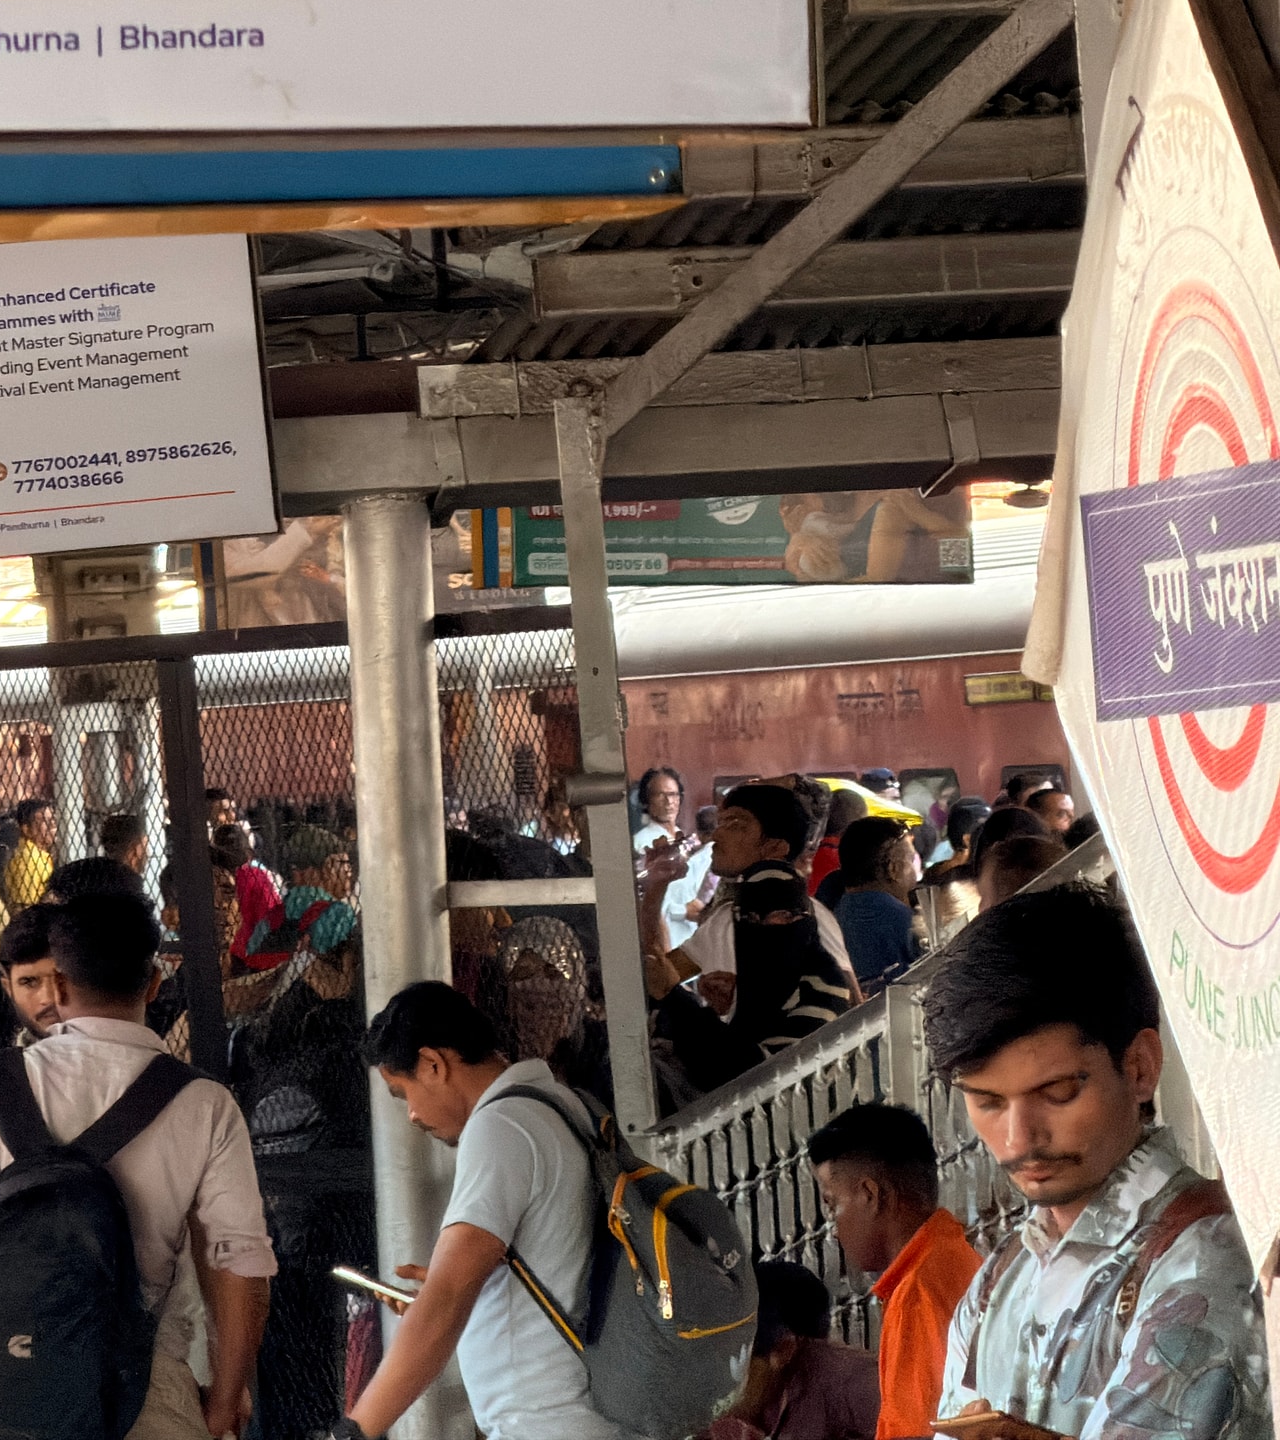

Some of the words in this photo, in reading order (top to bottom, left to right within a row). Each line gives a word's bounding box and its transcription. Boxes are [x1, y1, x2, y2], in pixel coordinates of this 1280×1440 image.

[119, 22, 265, 51] Bhandara
[68, 281, 156, 300] Certificate
[58, 308, 94, 324] with
[11, 336, 66, 351] Master
[67, 329, 144, 348] Signature
[146, 322, 215, 340] Program
[37, 355, 84, 372] Event
[85, 345, 189, 367] Management
[28, 378, 75, 396] Event
[77, 368, 182, 391] Management
[11, 451, 123, 475] 7767002441,
[125, 440, 237, 464] 8975862626,
[13, 470, 124, 494] 7774038666
[1144, 520, 1193, 674] पुणे
[1168, 928, 1226, 1044] PUNE
